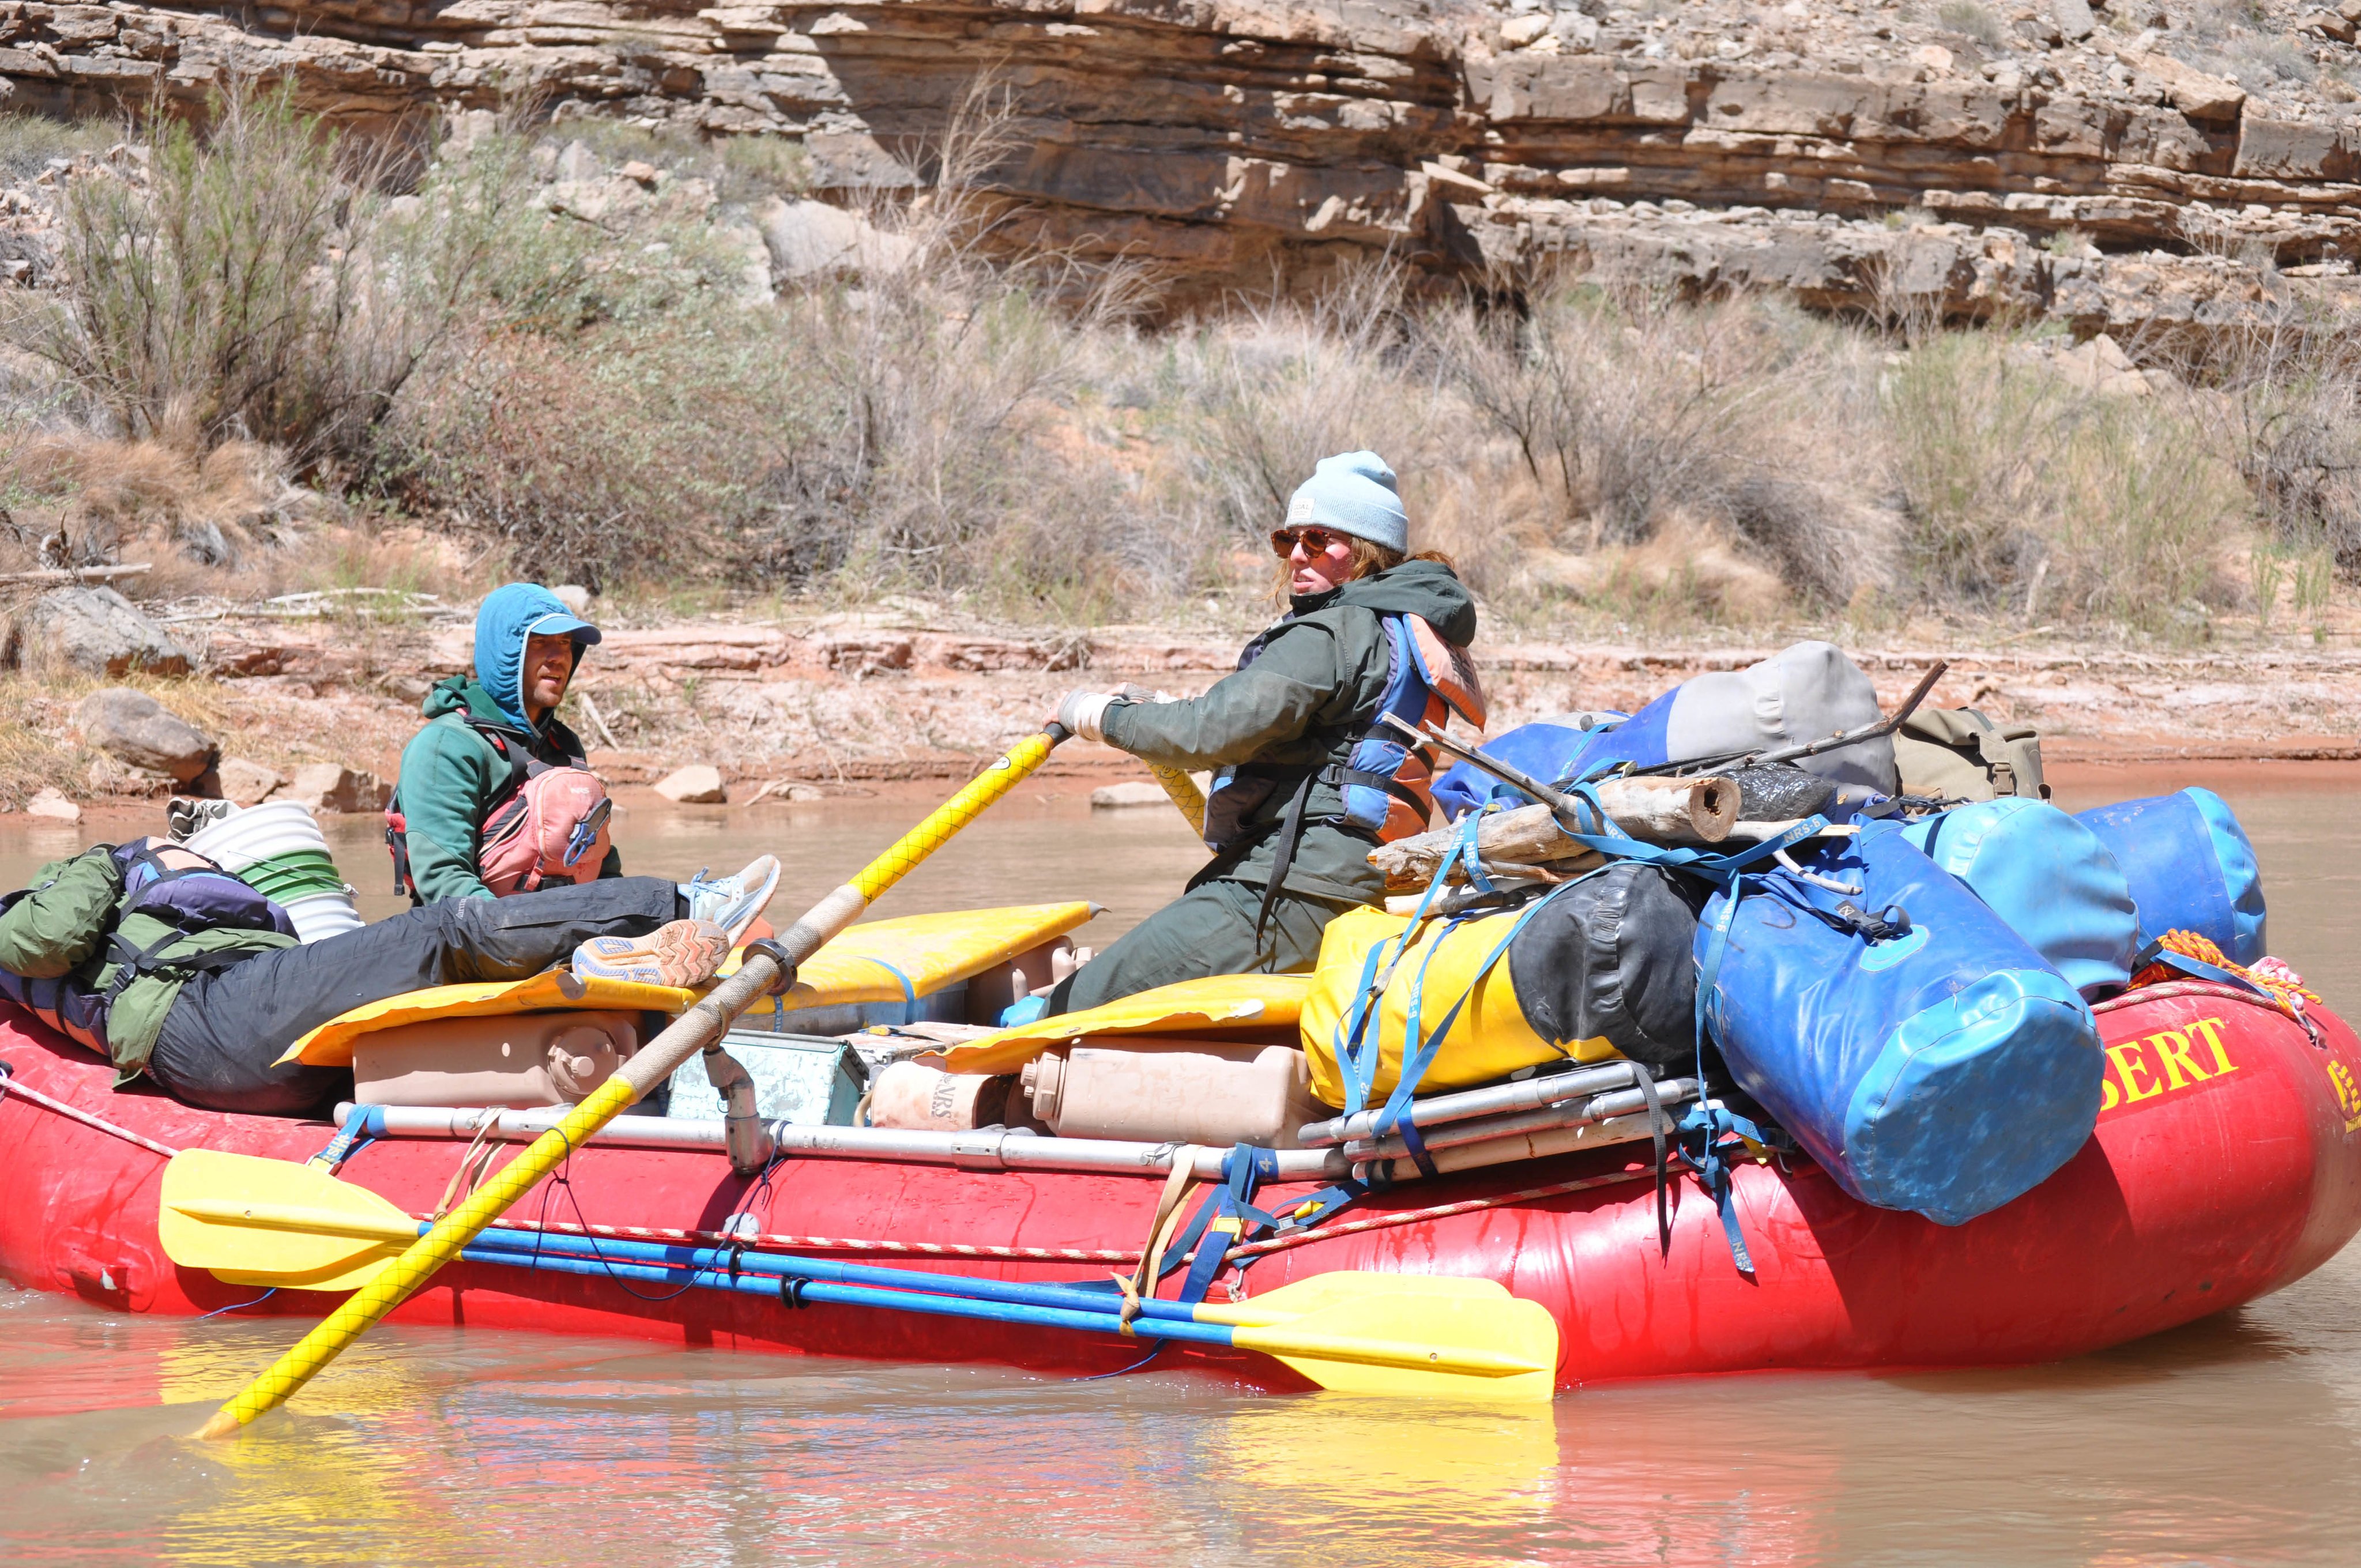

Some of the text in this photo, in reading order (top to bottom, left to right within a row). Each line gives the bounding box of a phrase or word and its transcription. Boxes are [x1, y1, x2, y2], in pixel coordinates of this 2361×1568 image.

[1783, 817, 1821, 843] NRS-6
[1466, 841, 1483, 881] NRS-6
[1716, 898, 1735, 932] NRS-6
[935, 1084, 957, 1118] NRS
